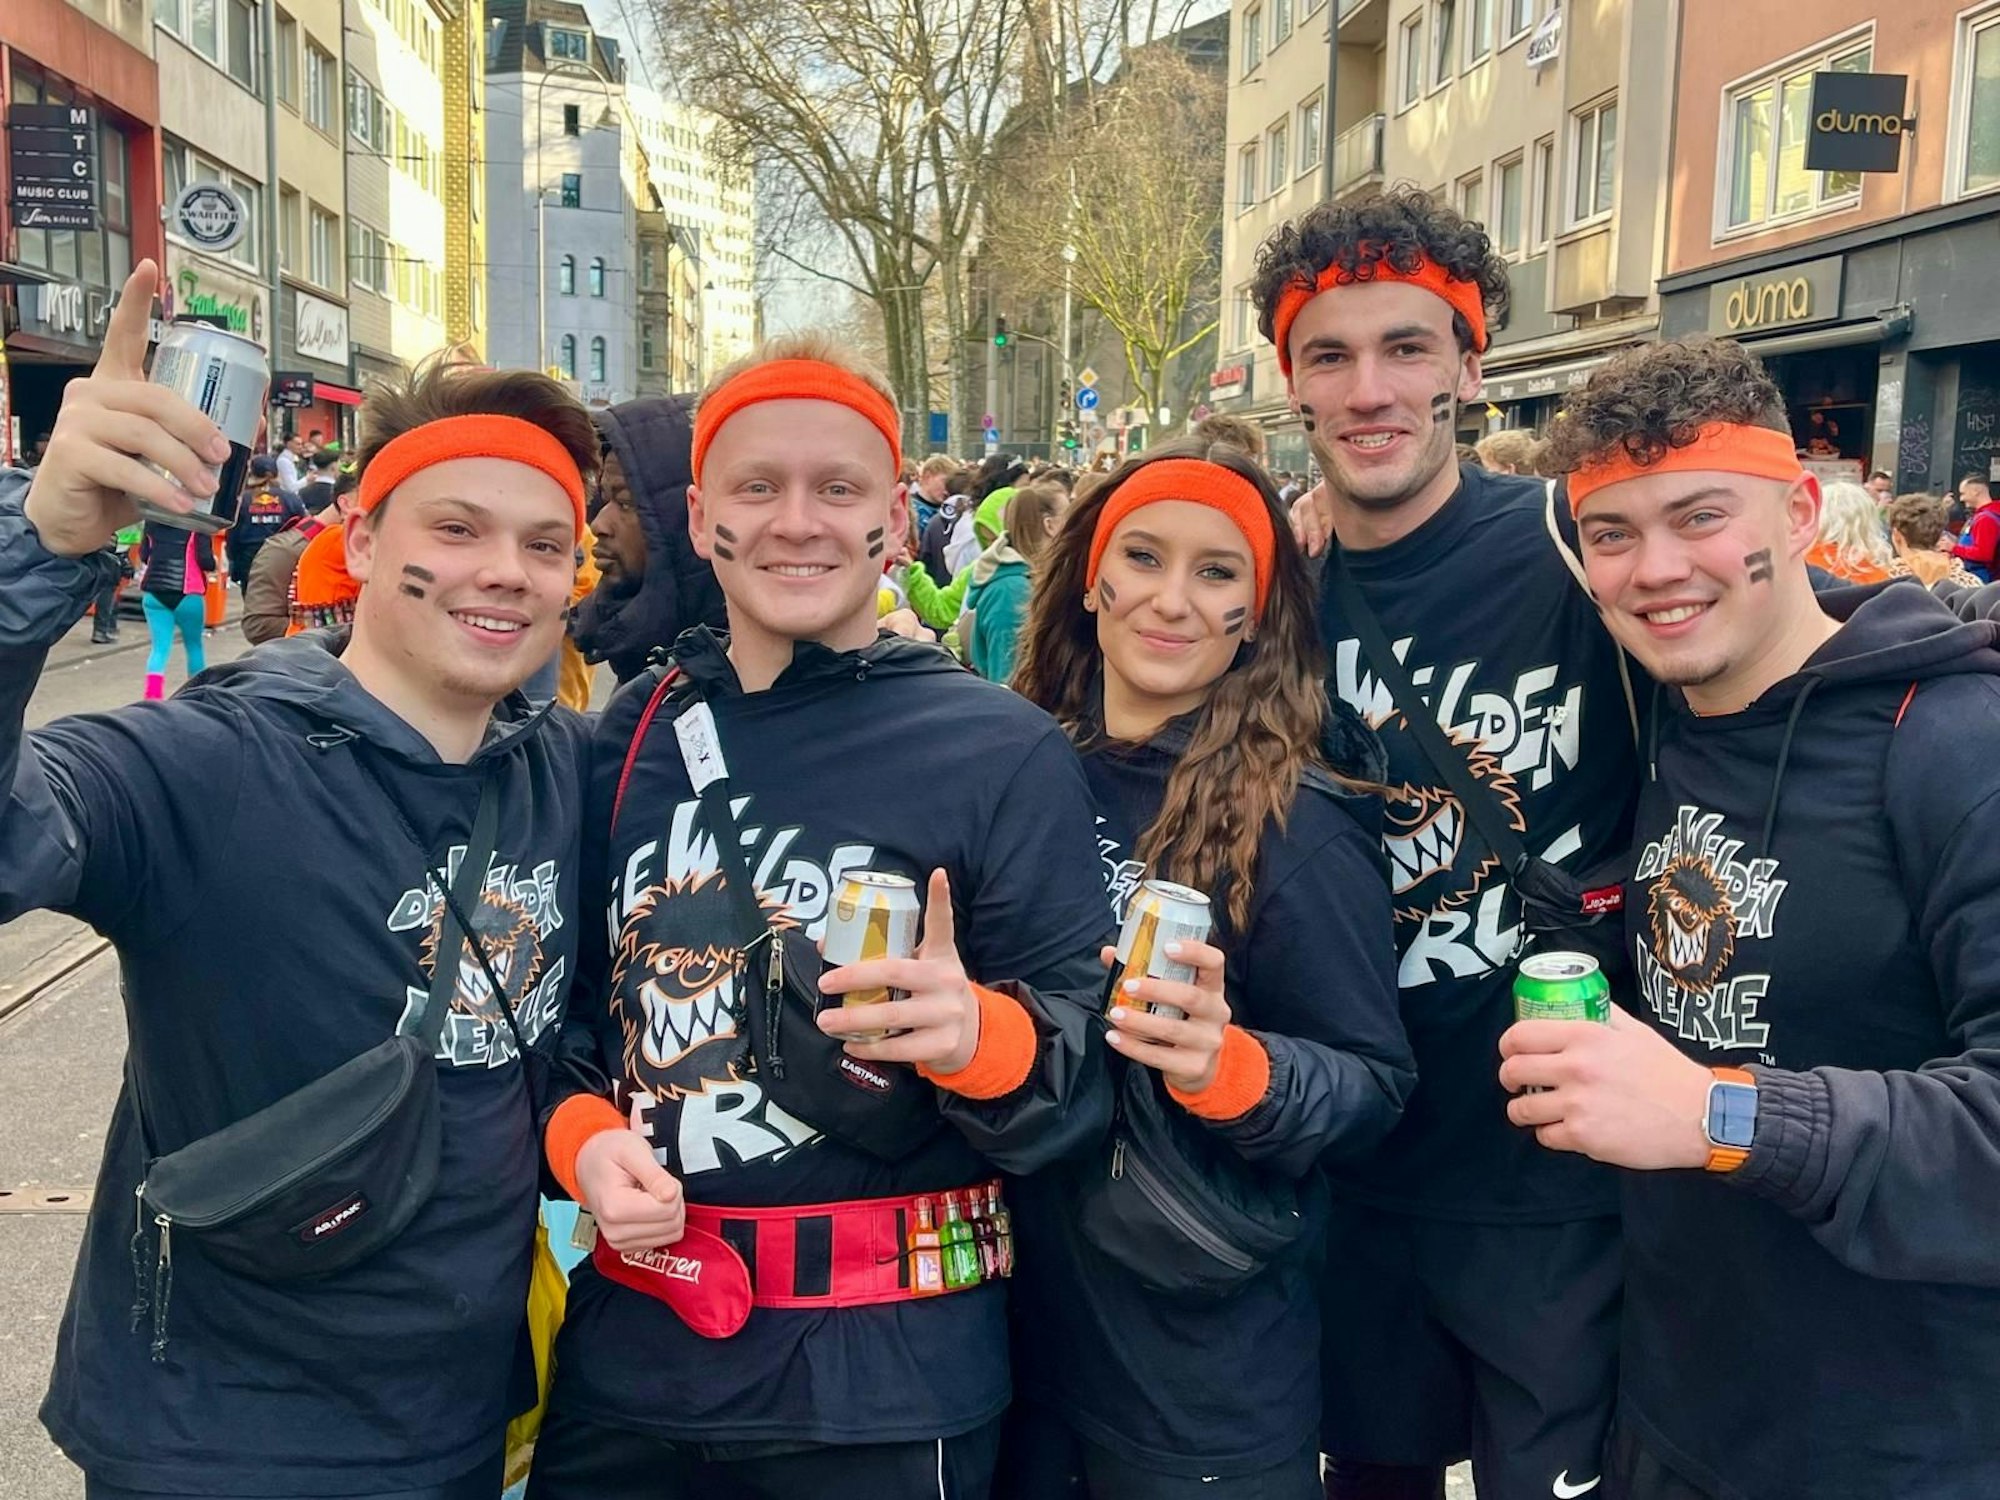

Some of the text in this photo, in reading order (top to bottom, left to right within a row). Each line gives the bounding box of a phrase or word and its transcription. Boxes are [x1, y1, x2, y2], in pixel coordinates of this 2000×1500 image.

[1816, 108, 1901, 134] duma
[17, 186, 89, 200] MUSIC CLUB
[45, 282, 82, 333] MTC
[1726, 277, 1809, 329] duma
[1636, 932, 1772, 1051] KERLE
[840, 1059, 887, 1089] EASTPAK
[1758, 1051, 1777, 1067] TM
